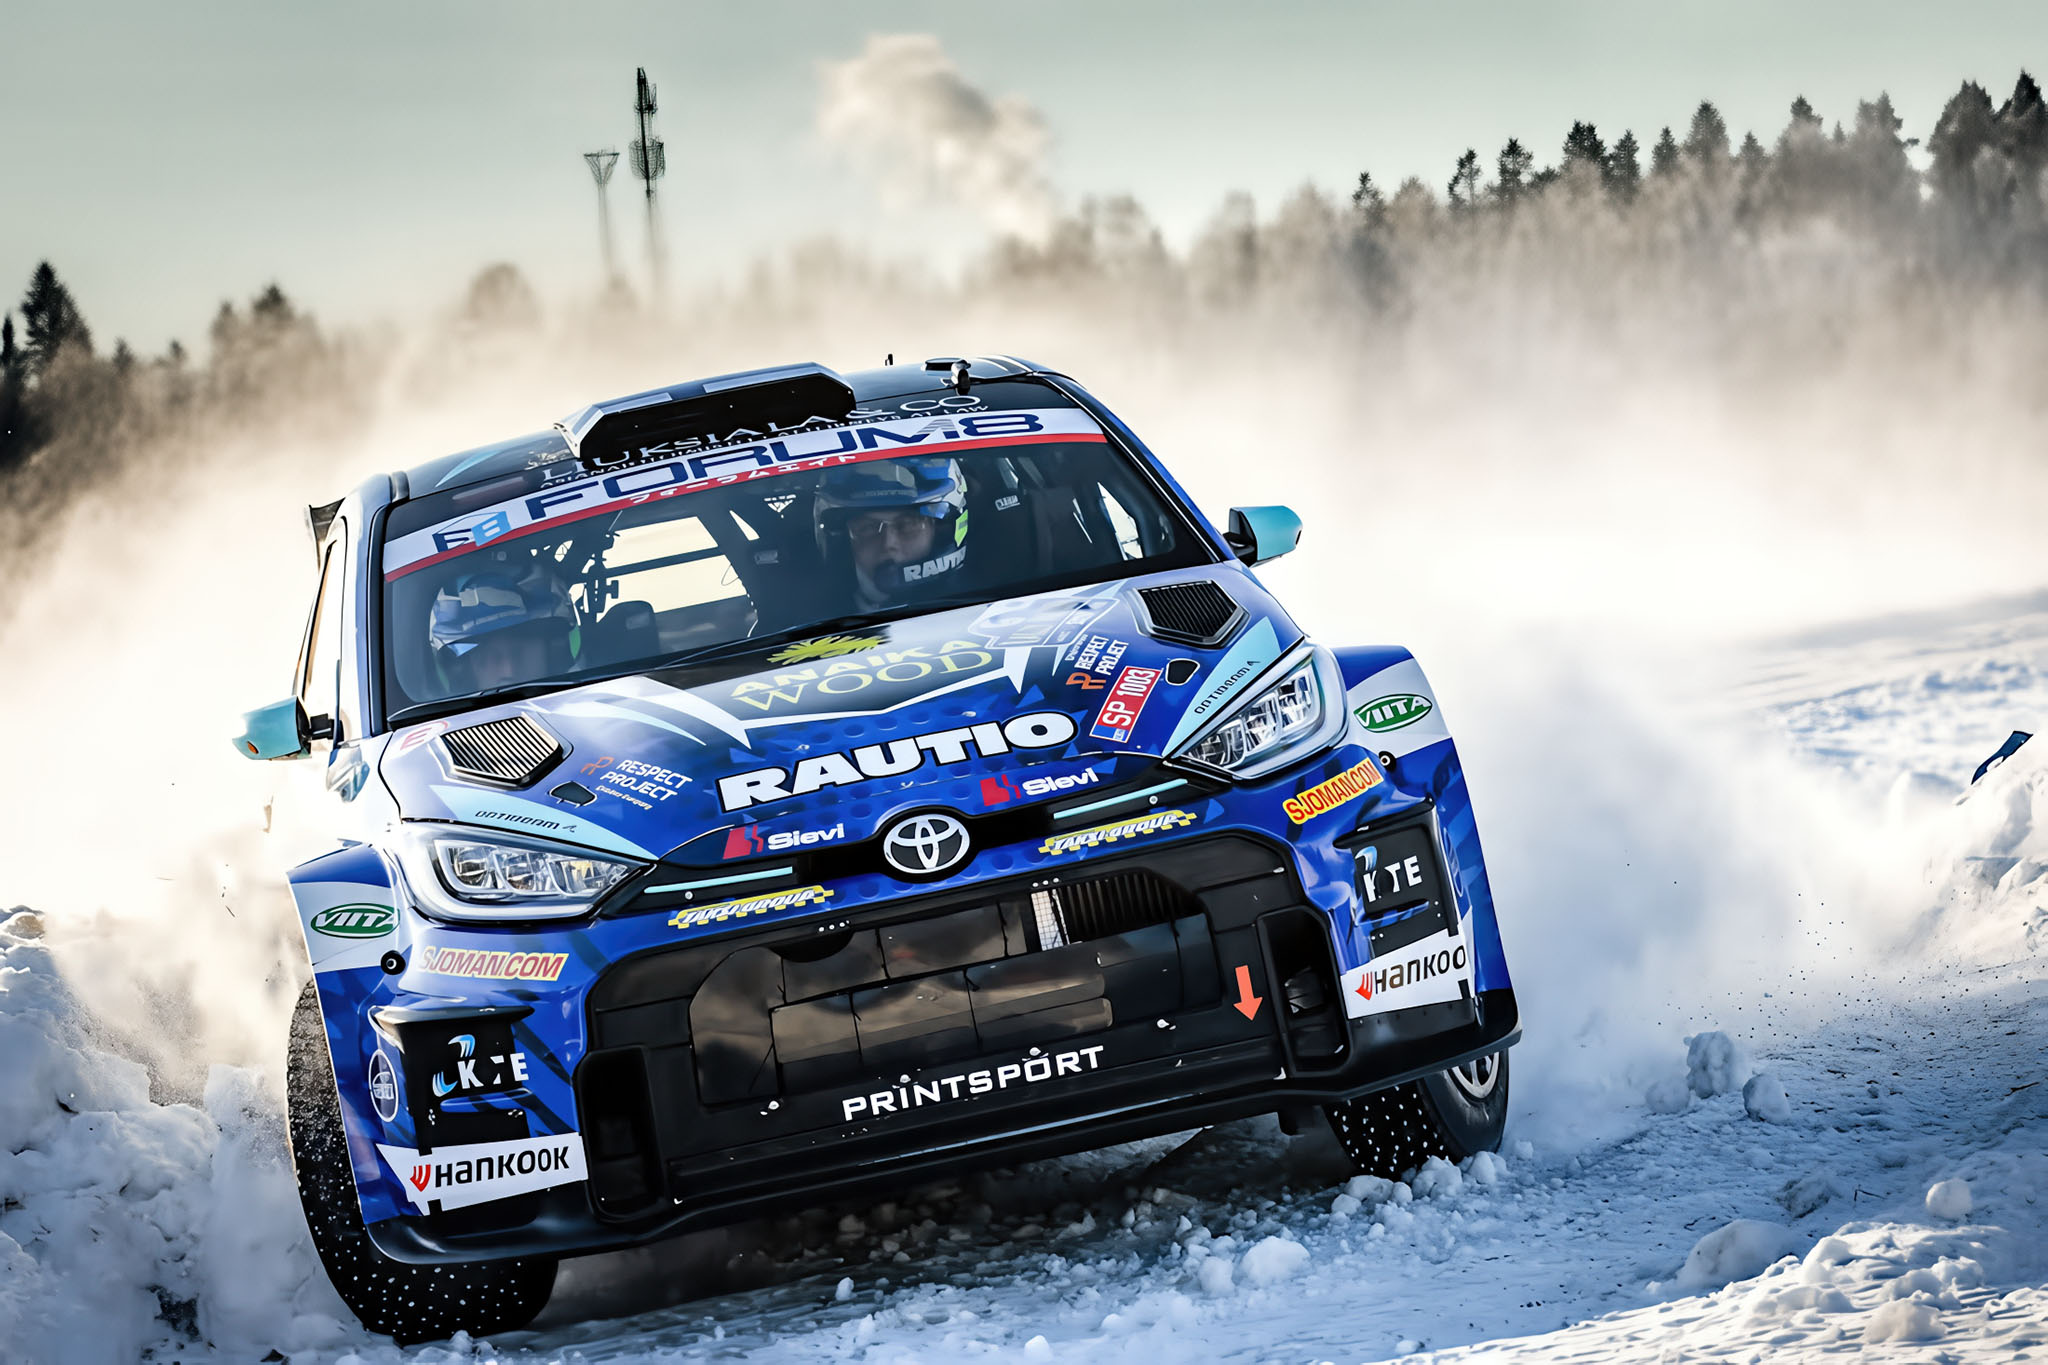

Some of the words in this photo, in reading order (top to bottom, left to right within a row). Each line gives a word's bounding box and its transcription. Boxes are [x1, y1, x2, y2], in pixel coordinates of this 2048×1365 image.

[900, 396, 981, 411] CO
[523, 412, 1044, 520] FORUM8
[731, 640, 983, 698] ANAIKA
[735, 650, 993, 711] WOOD
[1116, 668, 1157, 698] 1003
[1102, 701, 1135, 727] SP
[1353, 695, 1432, 730] VIITA
[615, 759, 694, 789] RESPECT
[717, 712, 1076, 812] RAUTIO
[600, 771, 678, 802] PROJECT
[1021, 767, 1099, 797] Sievi
[767, 823, 846, 851] Sievi
[314, 903, 400, 929] VIITA
[1374, 945, 1467, 995] HANKOO
[842, 1045, 1104, 1121] PRINTSPORT
[434, 1146, 570, 1188] HANKOOK
